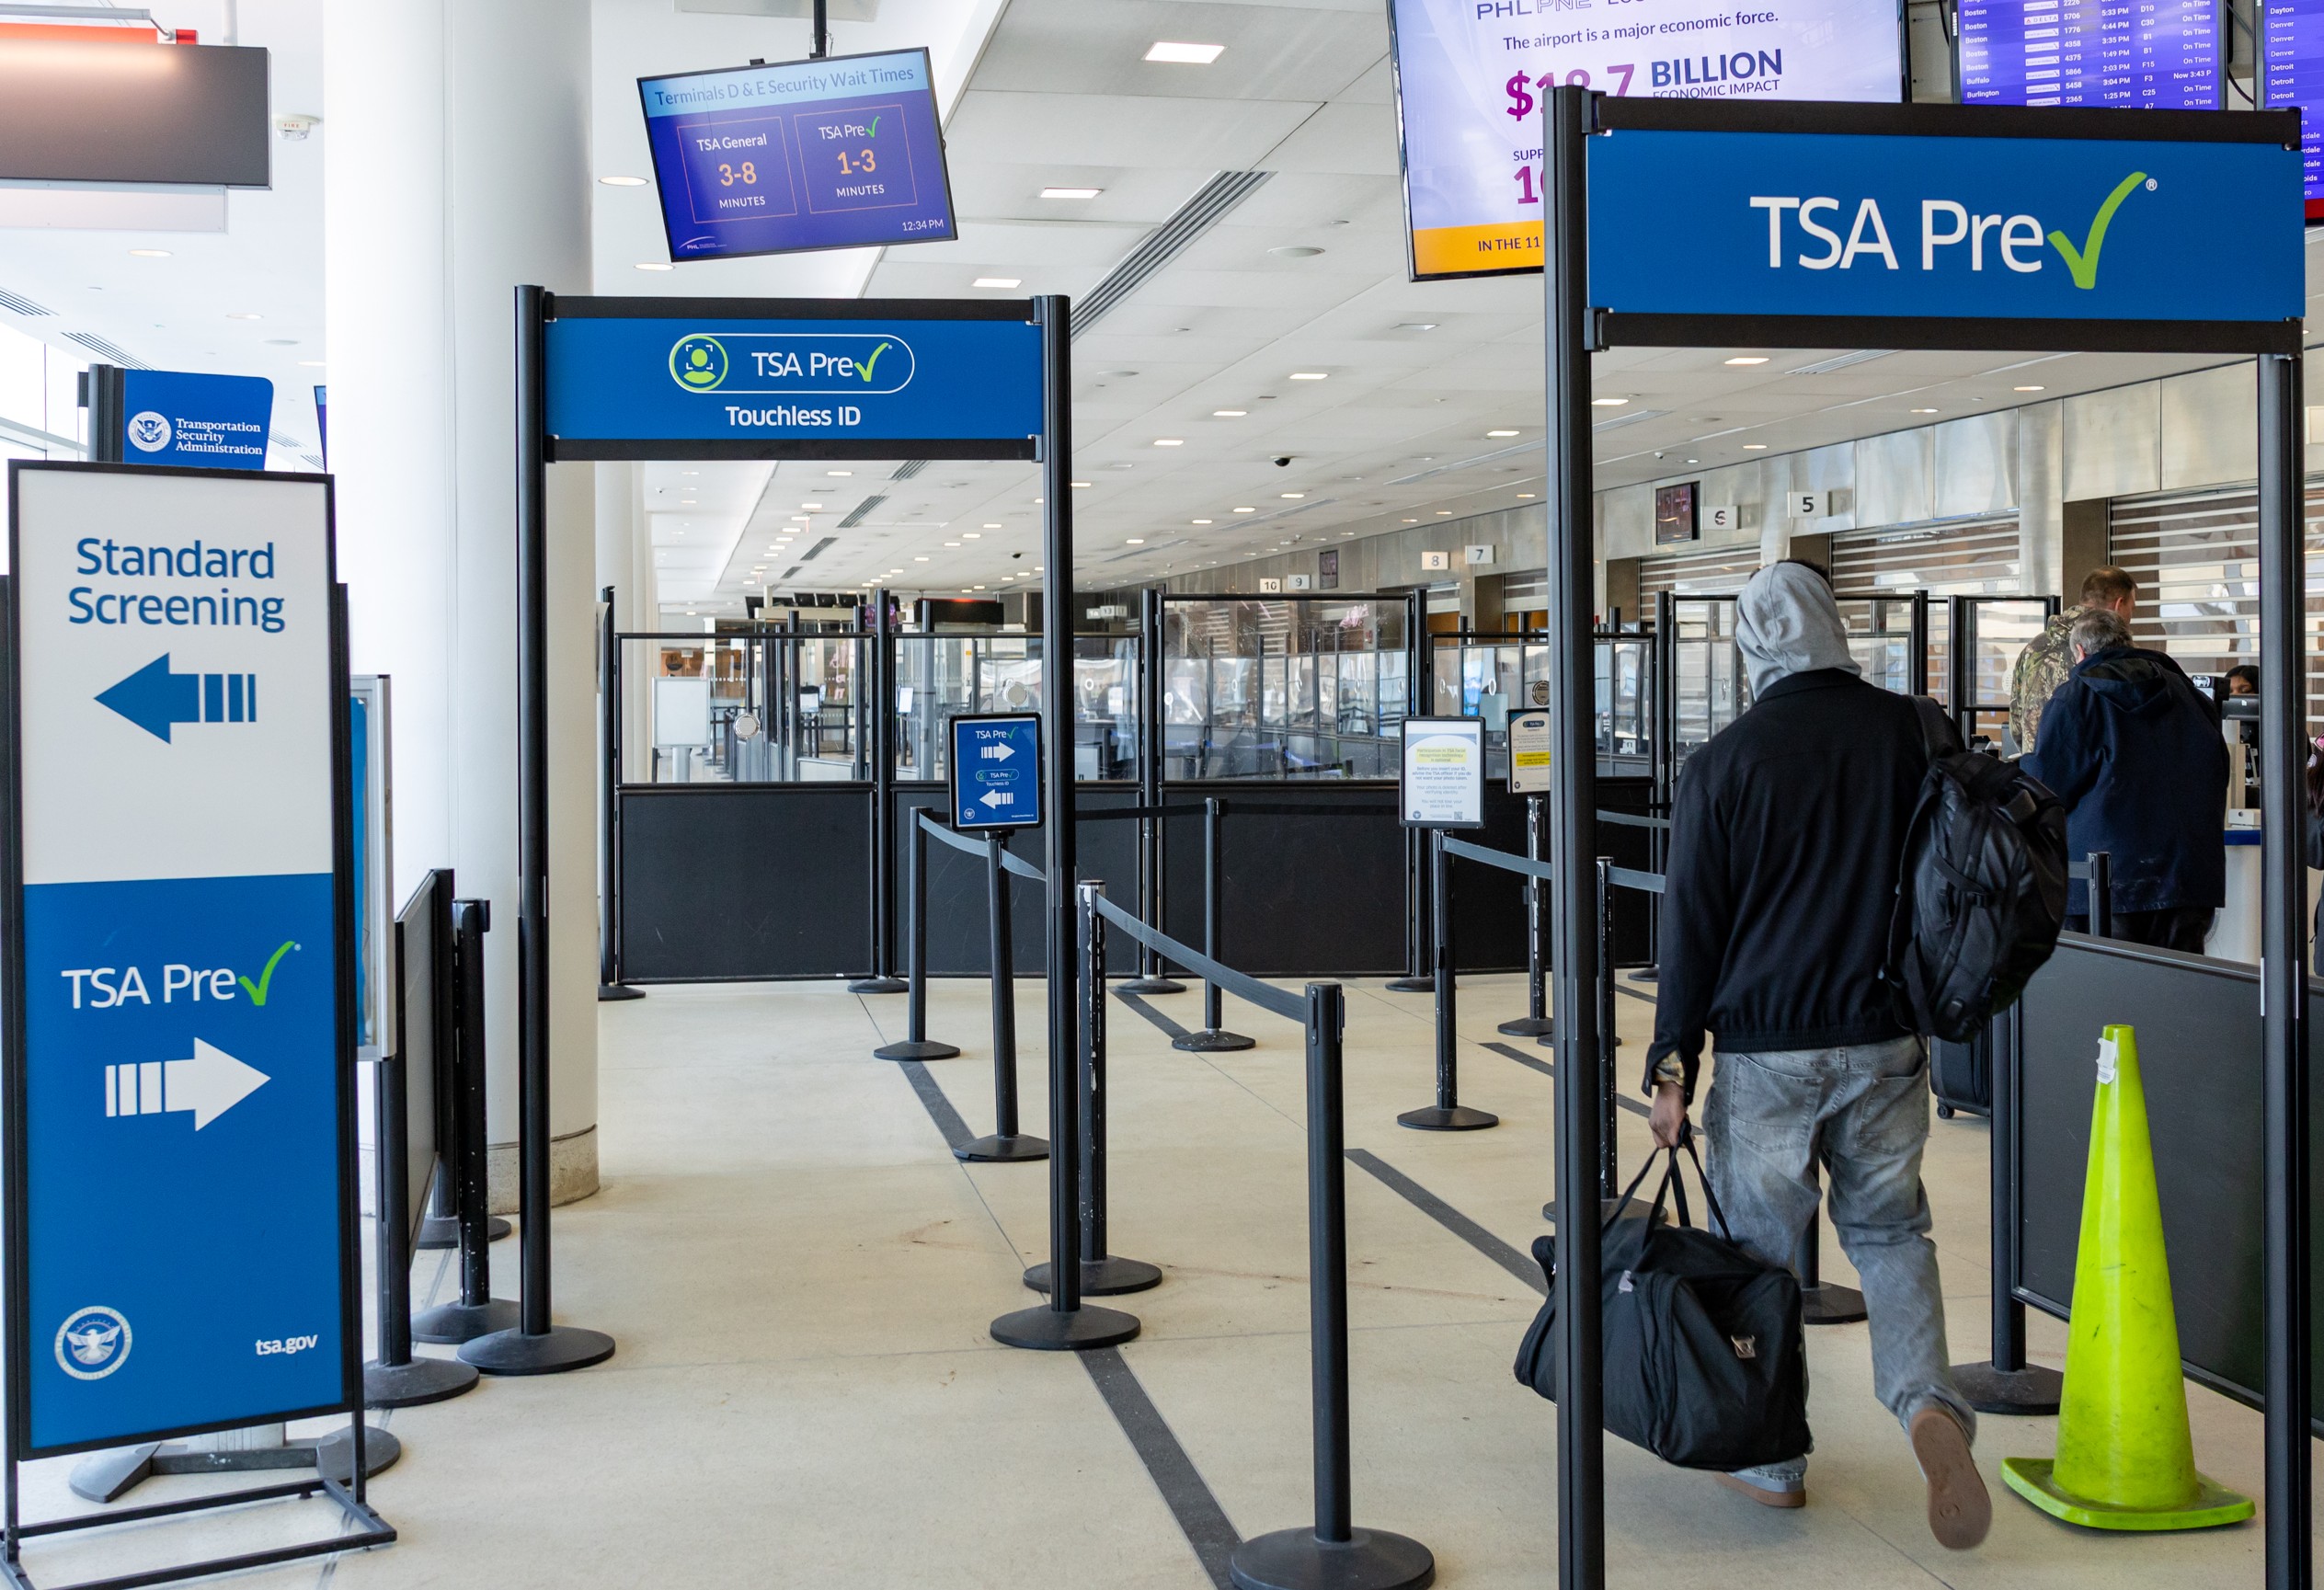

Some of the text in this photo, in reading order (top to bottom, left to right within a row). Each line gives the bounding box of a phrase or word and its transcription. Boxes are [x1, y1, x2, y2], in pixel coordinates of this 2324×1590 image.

[1477, 0, 1532, 19] PHL
[1964, 8, 1987, 17] Boston
[2101, 8, 2116, 17] 5:33
[2270, 6, 2295, 15] Dayton
[1503, 9, 1779, 50] The airport is a major economic force.
[2101, 22, 2116, 30] 4:44
[1651, 49, 1782, 87] BILLION
[2102, 64, 2117, 73] 2:03
[2271, 63, 2294, 72] Detroit
[655, 66, 914, 106] Terminals D & E Security Wait Times
[1729, 79, 1780, 97] IMPACT
[1966, 90, 1999, 98] Burlington
[2103, 78, 2118, 86] 3:04
[2173, 72, 2188, 80] Now
[2103, 92, 2118, 100] 1:25
[2271, 92, 2295, 100] Detroit
[819, 123, 865, 140] TSA Pre
[696, 133, 767, 152] TSA General
[837, 148, 876, 175] 1-3
[1513, 148, 1544, 161] SUPP
[718, 162, 757, 187] 3-8
[836, 185, 885, 198] MINUTES
[719, 196, 766, 209] MINUTES
[902, 219, 944, 232] 12:34 PM
[1749, 196, 2044, 272] TSA Pre
[1478, 240, 1492, 252] IN
[1495, 237, 1521, 250] THE
[751, 351, 853, 378] TSA Pre
[725, 406, 861, 427] Touchless ID
[175, 418, 261, 433] Transportation
[176, 430, 224, 445] Security
[175, 441, 263, 455] Administration
[1803, 497, 1814, 512] 5
[1714, 510, 1726, 525] 6
[76, 537, 275, 579] Standard
[1431, 555, 1439, 566] 8
[1475, 548, 1483, 561] 7
[1265, 581, 1277, 590] 10
[1295, 578, 1302, 587] 9
[68, 587, 286, 634] Screening
[975, 729, 1007, 739] TSA Pre
[61, 964, 236, 1010] TSA Pre
[255, 1332, 318, 1356] tsa.gov
